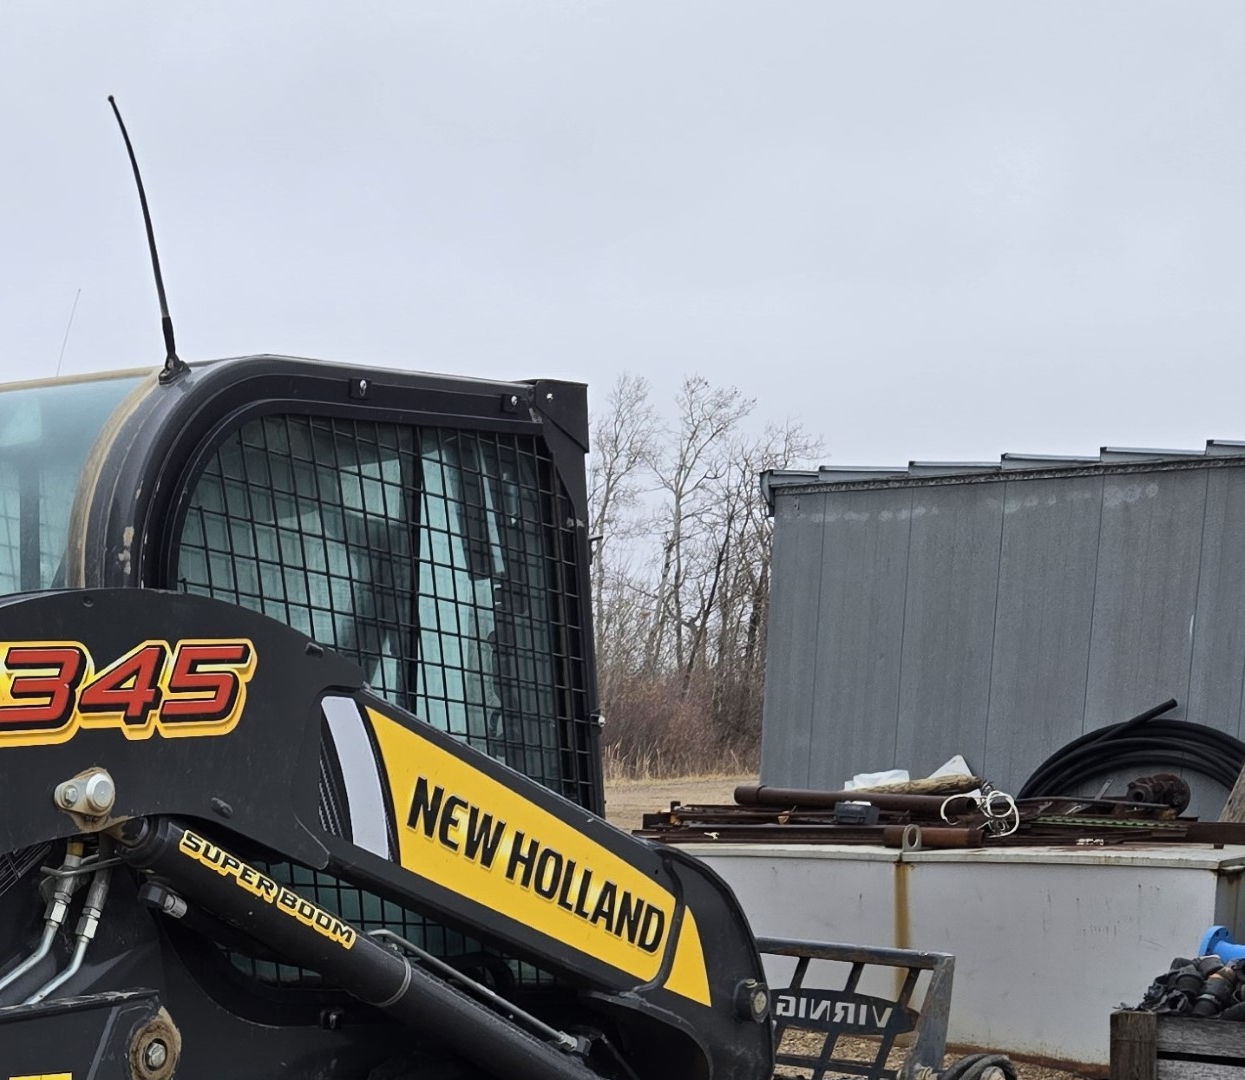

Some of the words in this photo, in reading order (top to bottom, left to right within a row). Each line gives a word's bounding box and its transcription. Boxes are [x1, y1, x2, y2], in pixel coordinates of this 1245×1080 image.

[179, 830, 277, 904] SUPER
[276, 887, 356, 949] BOOM
[406, 776, 507, 869] NEW
[505, 830, 665, 954] HOLLAND
